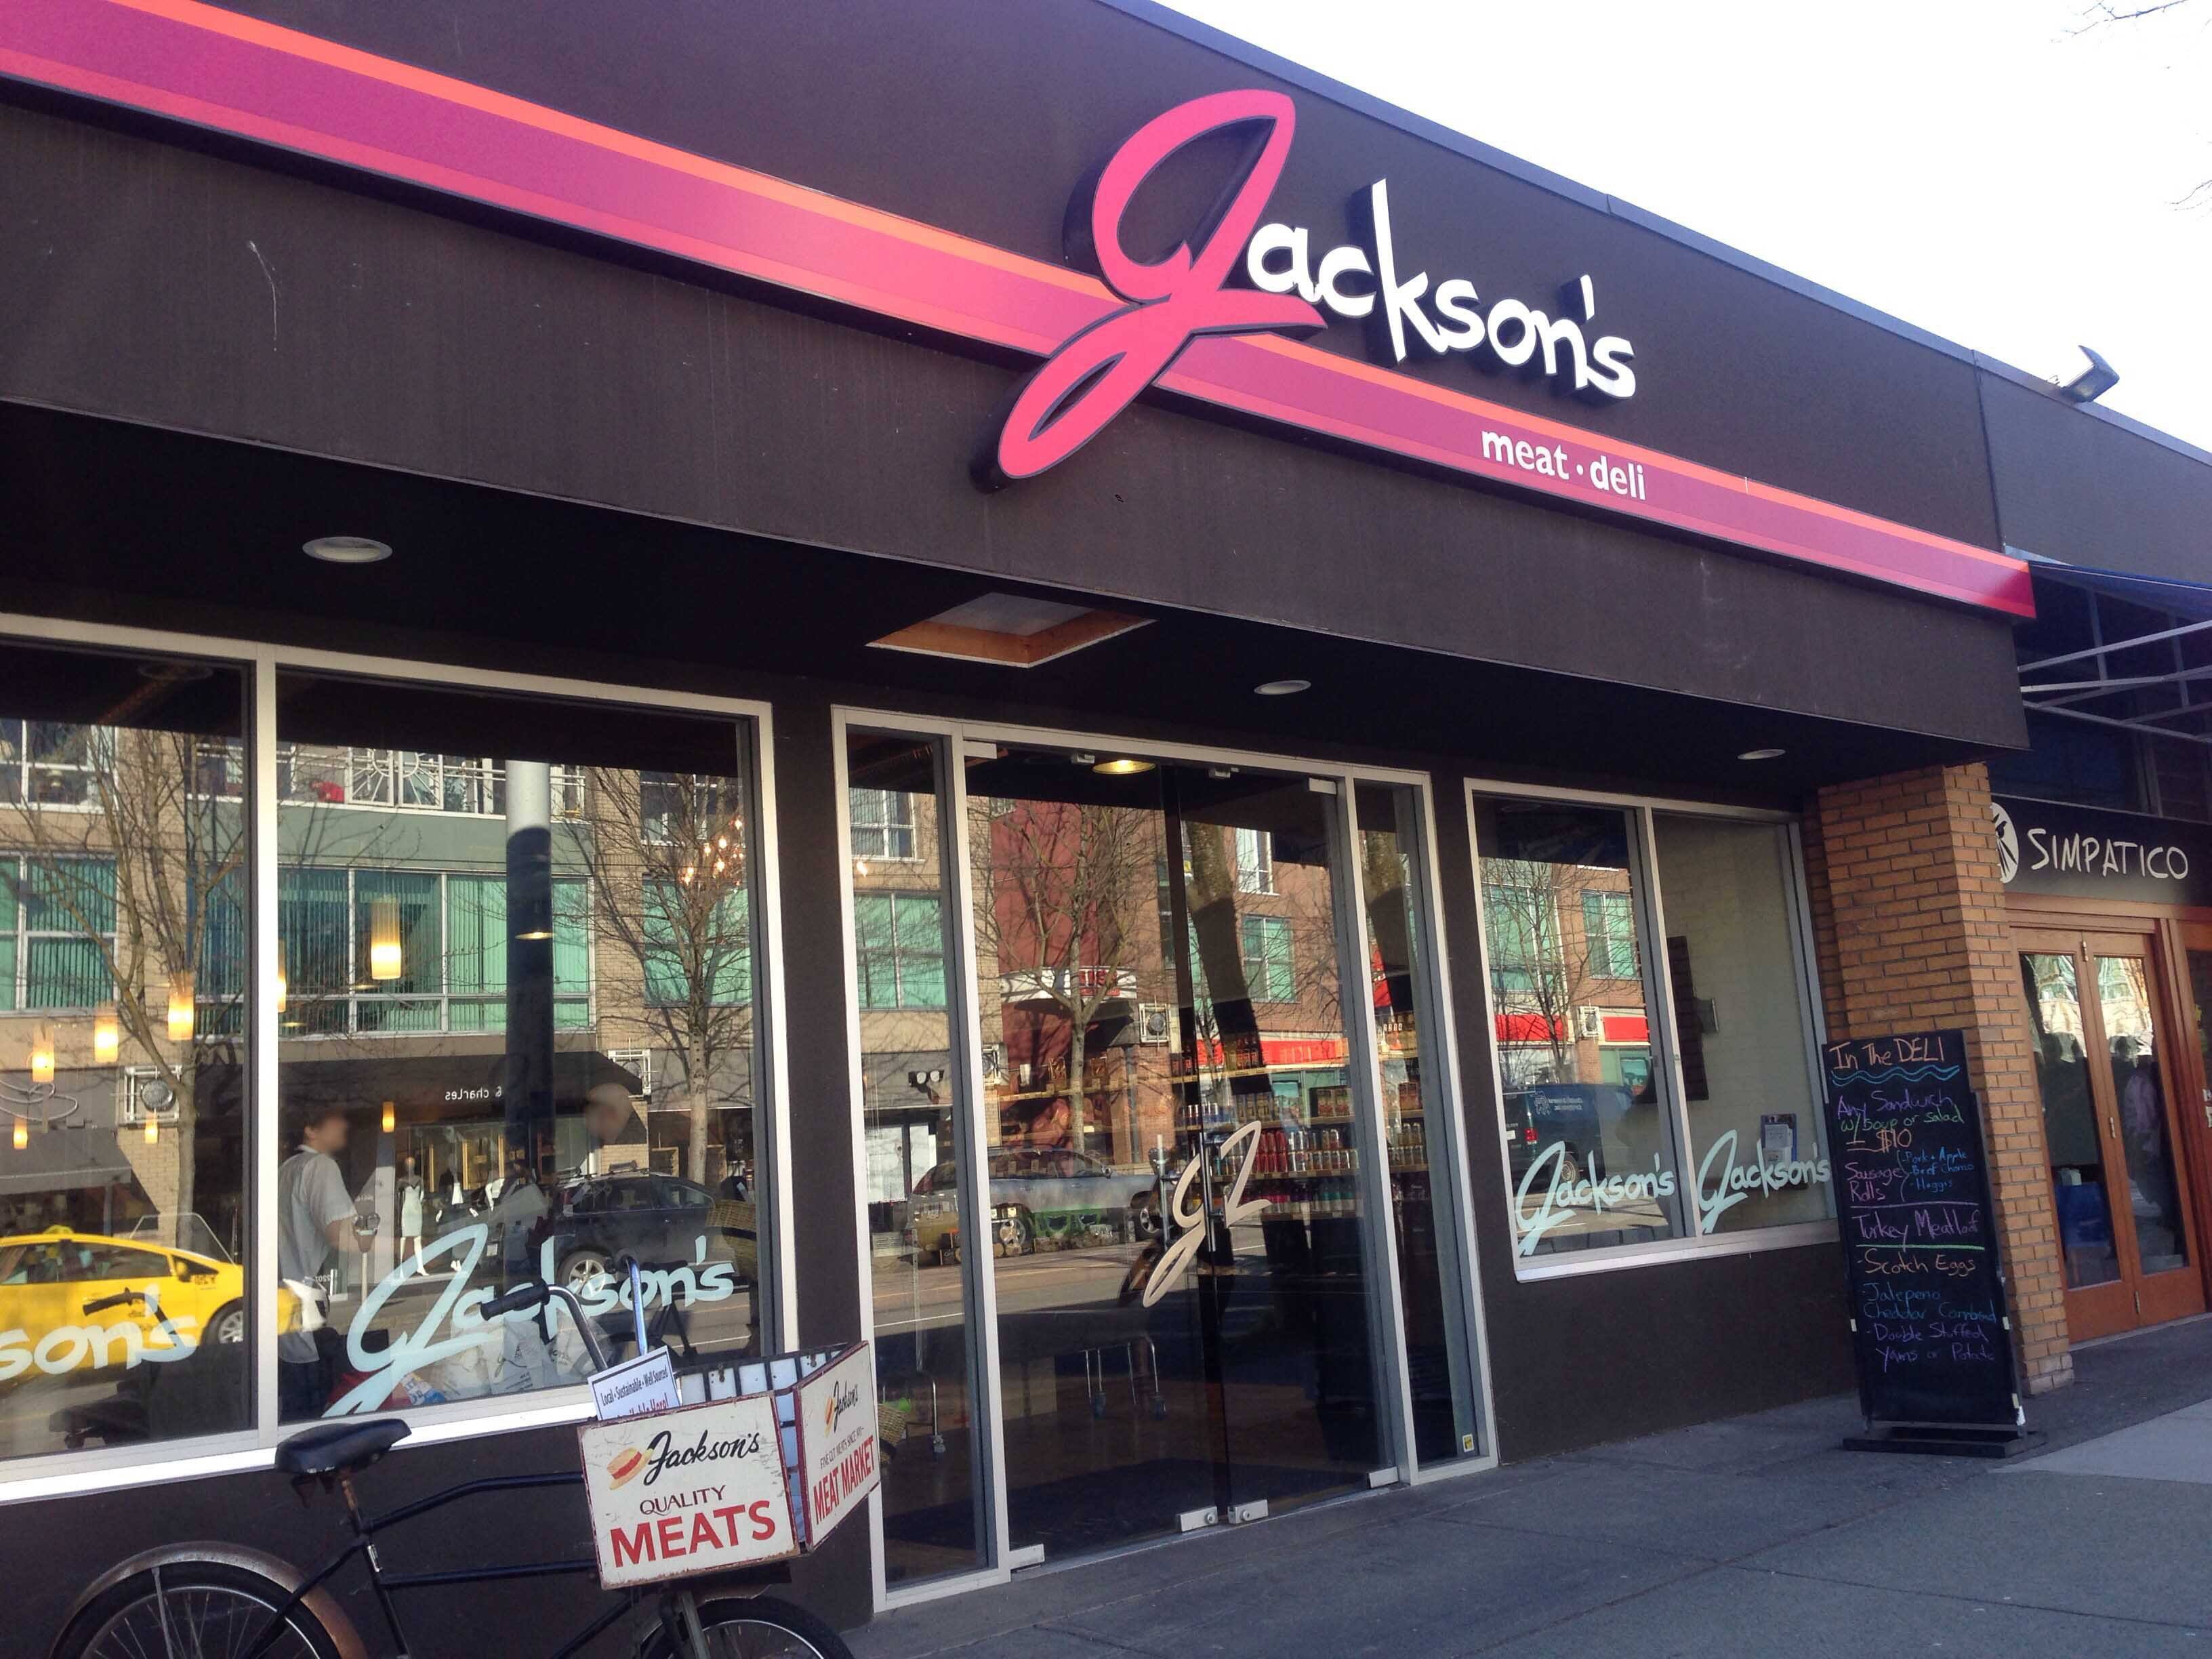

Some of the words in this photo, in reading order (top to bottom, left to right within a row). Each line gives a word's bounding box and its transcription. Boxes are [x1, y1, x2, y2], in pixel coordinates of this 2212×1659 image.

[998, 89, 1637, 479] Jackson's
[1481, 430, 1570, 480] meat
[1590, 455, 1645, 500] deli
[2027, 828, 2188, 880] SIMPATICO
[1830, 1042, 1858, 1069] In
[1862, 1043, 1893, 1065] The
[1893, 1036, 1944, 1063] DELI
[1837, 1095, 1867, 1128] Any
[1871, 1088, 1953, 1112] Sandwich
[1904, 1115, 1919, 1126] or
[1924, 1104, 1965, 1124] salad
[1876, 1128, 1912, 1153] $10
[1697, 1129, 1830, 1233] Jackson's
[1845, 1162, 1904, 1186] Sausage
[1849, 1181, 1885, 1202] Rolls
[1515, 1141, 1675, 1256] Jackson's
[1851, 1211, 1908, 1252] Turkey
[1914, 1207, 1979, 1240] Meatloaf
[1936, 1254, 1976, 1277] Eggs
[600, 1387, 615, 1406] Local
[615, 1377, 642, 1399] Sustainable
[834, 1380, 859, 1433] Jackson's
[643, 1430, 760, 1486] Jackson's
[813, 1467, 840, 1525] MEAT
[840, 1435, 875, 1500] MARKET
[640, 1485, 726, 1516] QUALITY
[610, 1500, 775, 1568] MEATS
